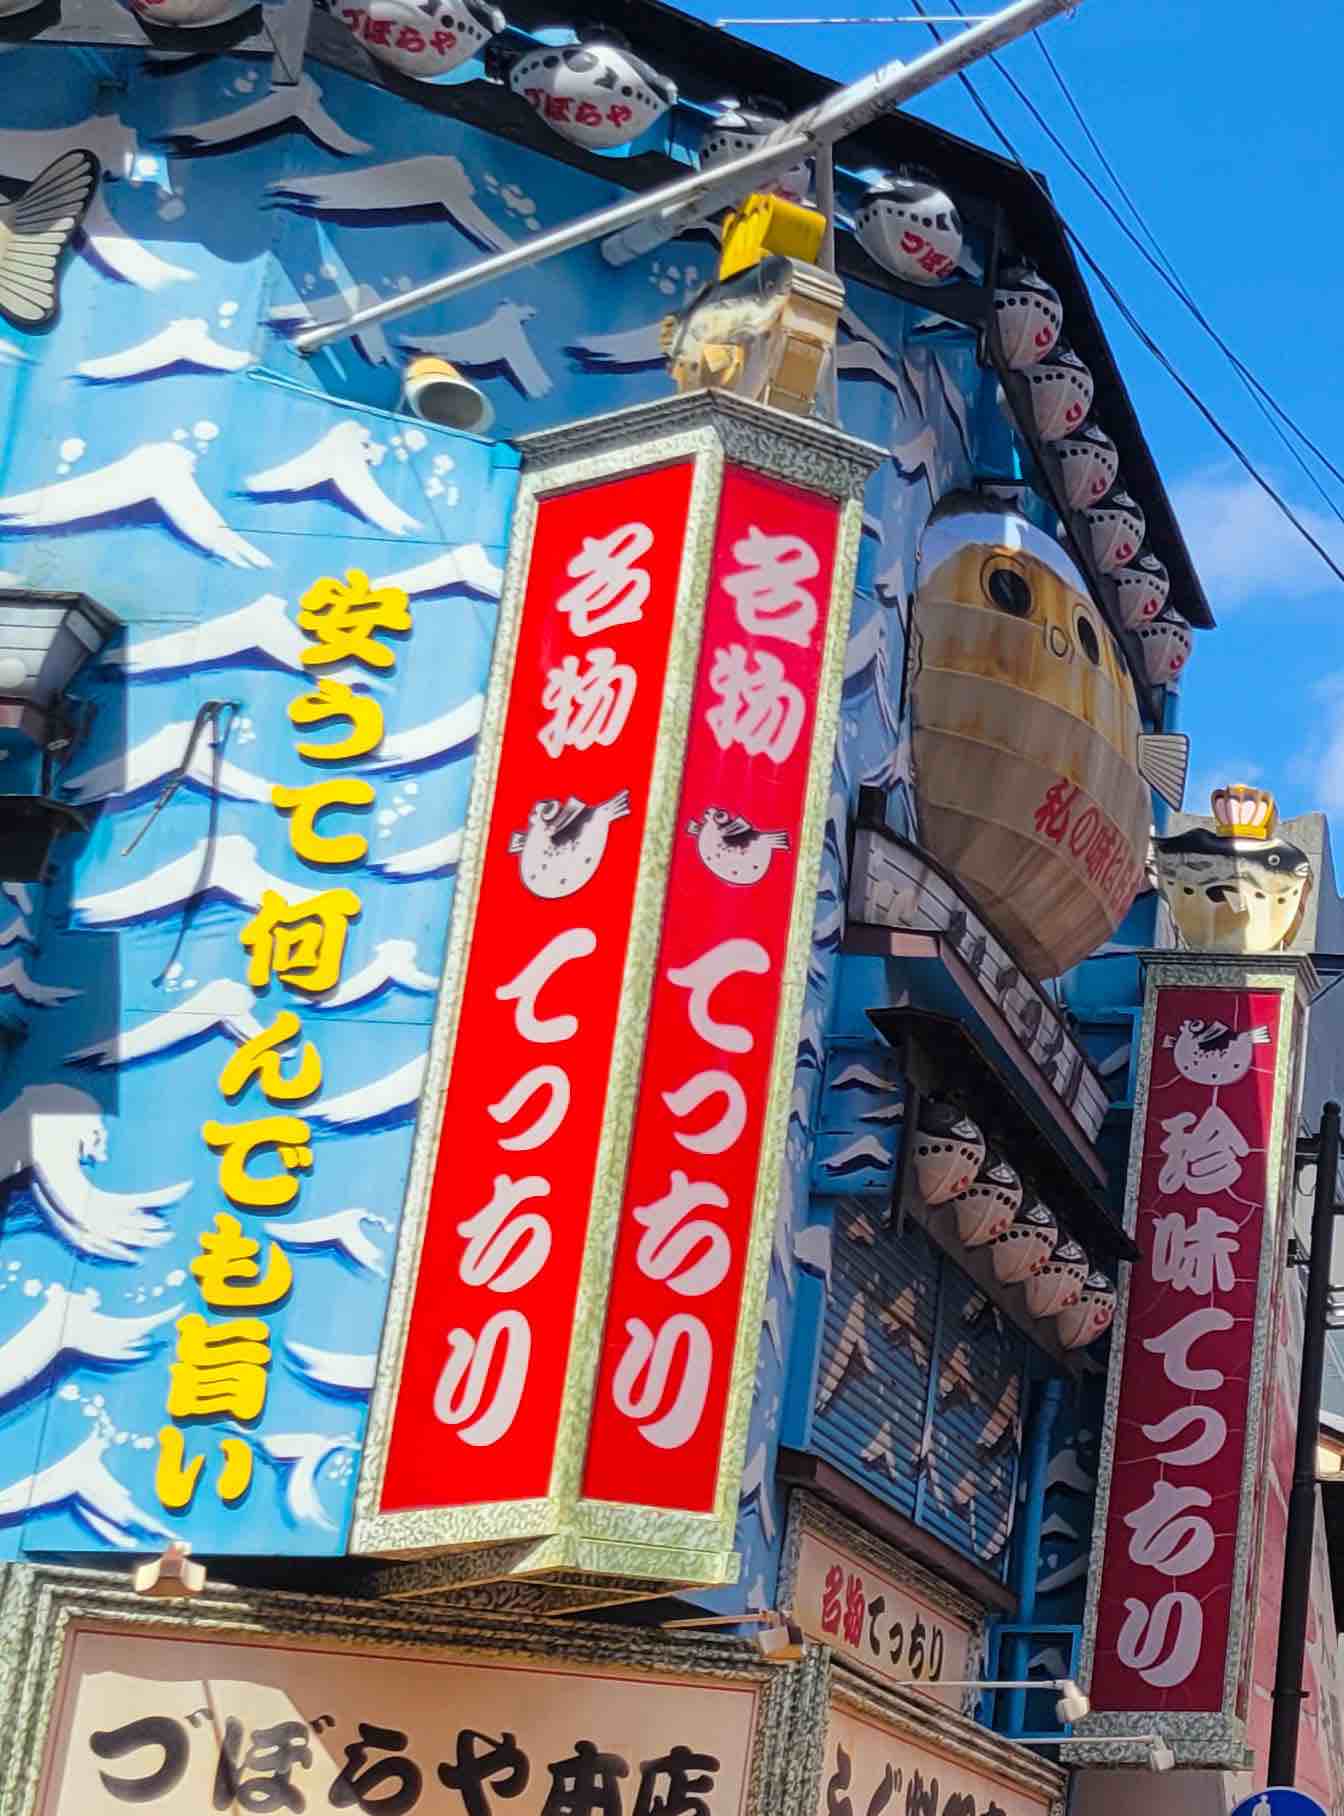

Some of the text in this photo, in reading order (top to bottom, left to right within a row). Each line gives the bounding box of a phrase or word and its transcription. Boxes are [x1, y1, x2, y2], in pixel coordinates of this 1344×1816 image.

[342, 9, 457, 55] づぼらや
[525, 88, 633, 127] づぼらや
[155, 569, 412, 1509] 安うて何んでも旨い
[433, 522, 655, 1448] 名物 てっちり
[611, 526, 822, 1450] 名物 てっちり
[820, 1564, 944, 1683] 名物てっちり
[1116, 1112, 1252, 1688] 珍味てっちり
